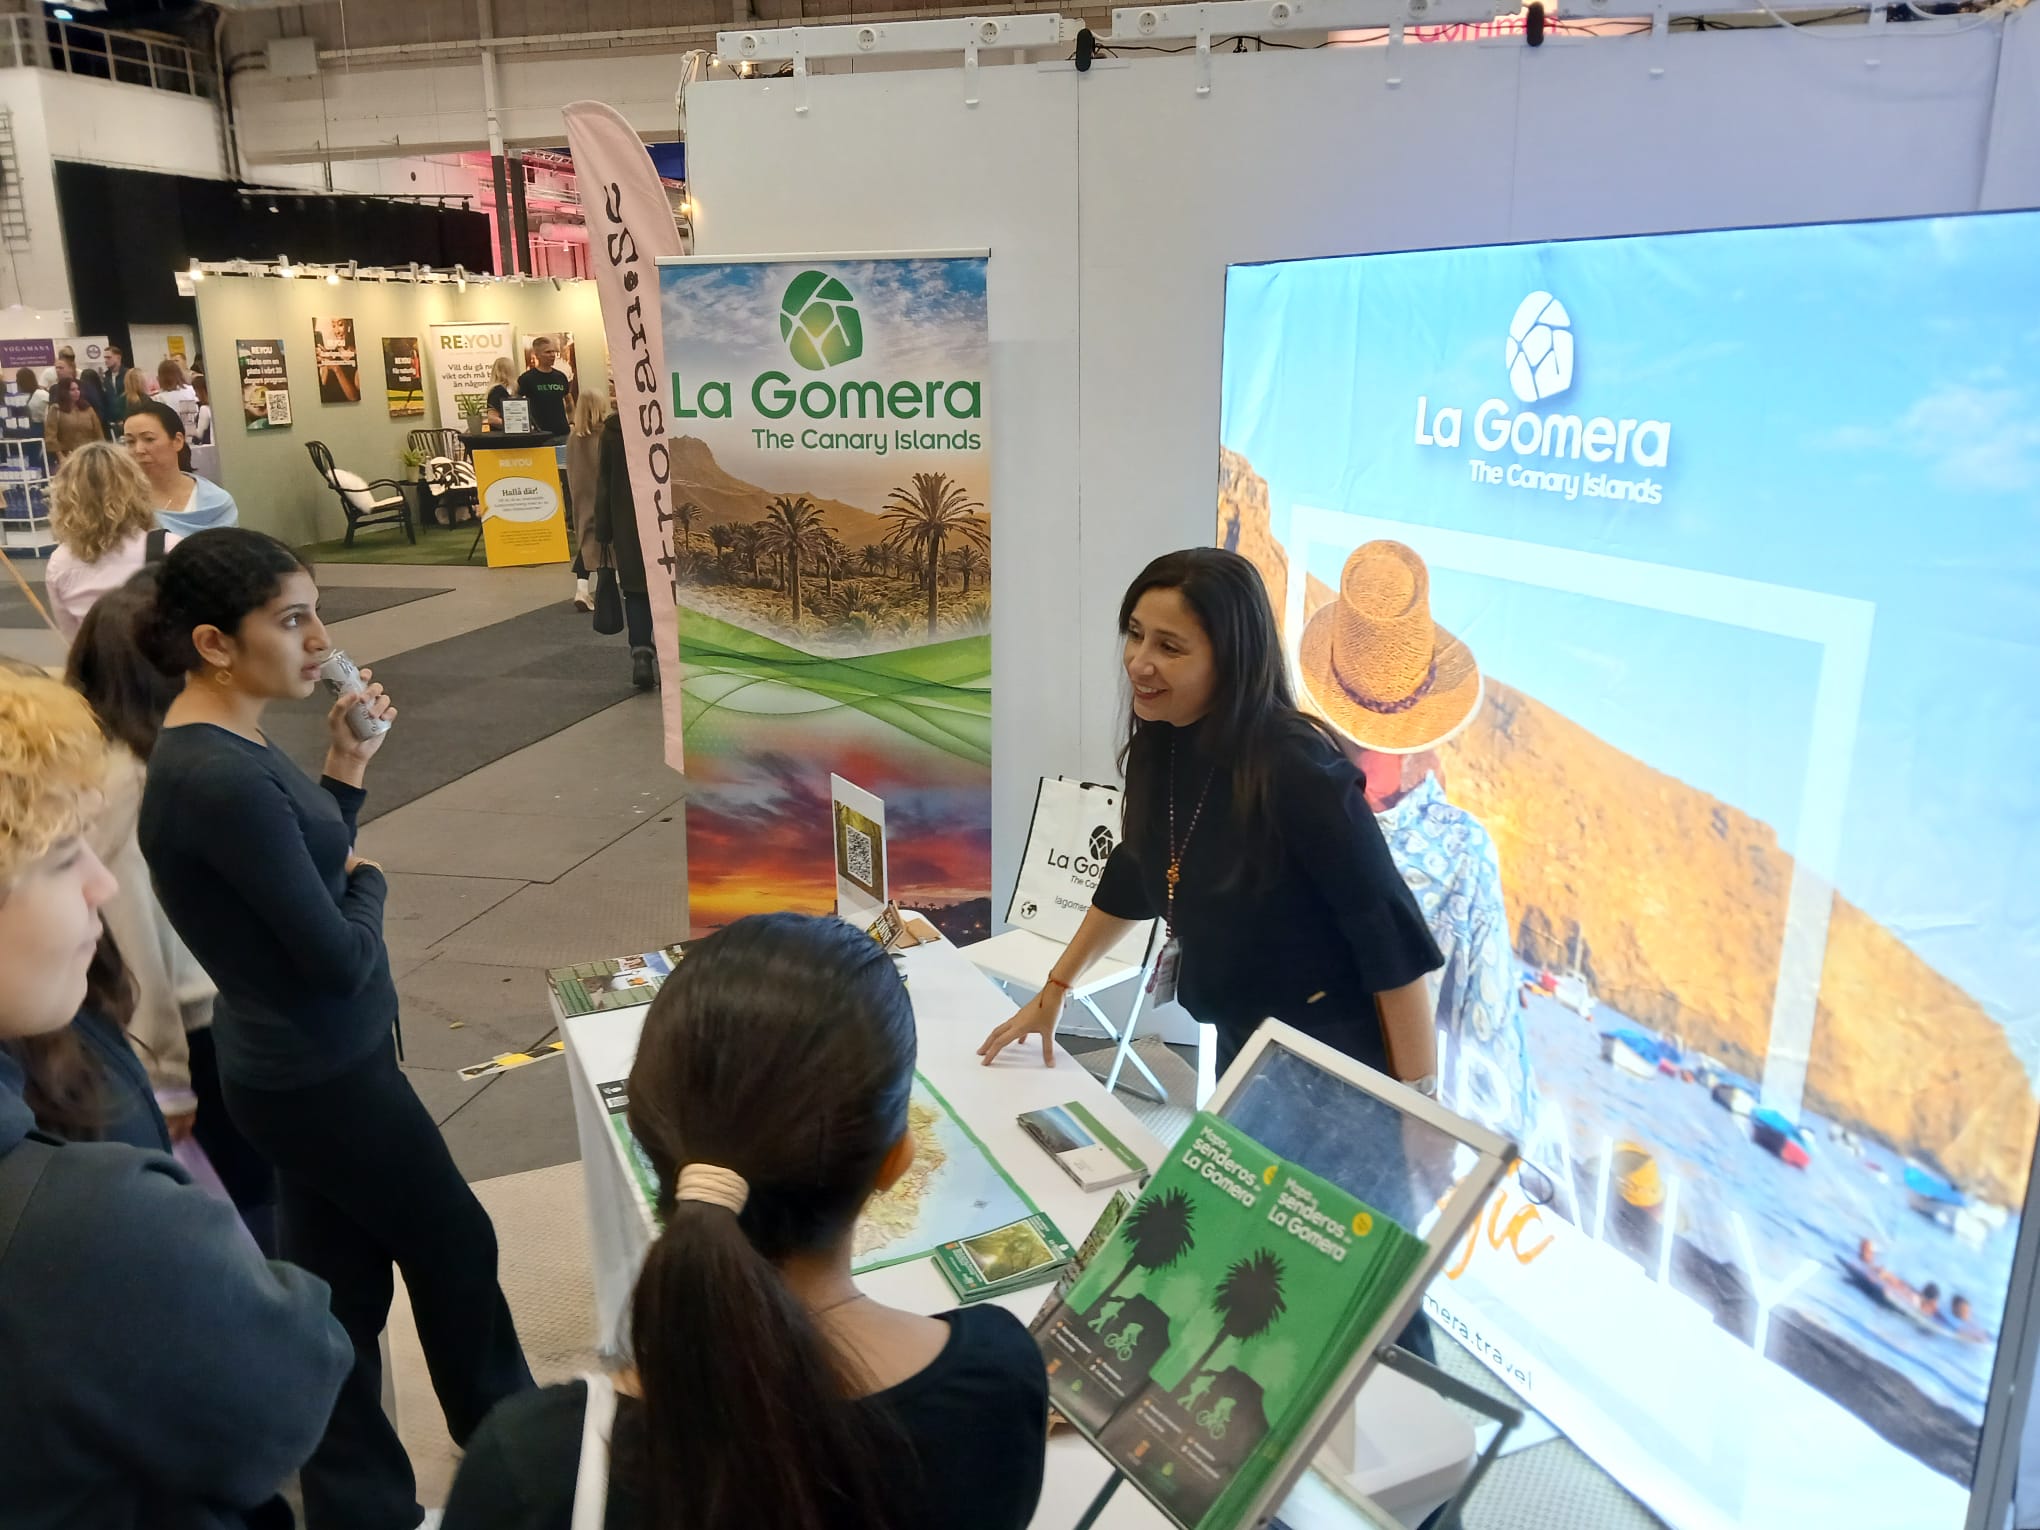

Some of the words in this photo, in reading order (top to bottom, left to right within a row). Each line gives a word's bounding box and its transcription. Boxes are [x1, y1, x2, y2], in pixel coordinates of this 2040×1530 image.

[440, 334, 502, 349] RE:YOU
[671, 371, 732, 419] La
[751, 370, 981, 419] Gomera
[751, 428, 794, 449] The
[801, 429, 888, 455] Canary
[895, 429, 981, 450] Islands
[1415, 396, 1462, 448] La
[1474, 398, 1671, 468] Gomera
[502, 487, 522, 496] Hallå
[1469, 459, 1503, 485] The
[1506, 464, 1580, 501] Canary
[1583, 472, 1663, 504] Islands
[1048, 848, 1069, 869] La
[1071, 875, 1084, 885] The
[1085, 880, 1098, 888] Ca
[1182, 1149, 1201, 1170] La
[1201, 1162, 1256, 1207] Gomera
[1192, 1138, 1257, 1186] senderos
[1267, 1204, 1288, 1227] La
[1287, 1217, 1347, 1262] Gomera
[1277, 1192, 1346, 1239] senderos
